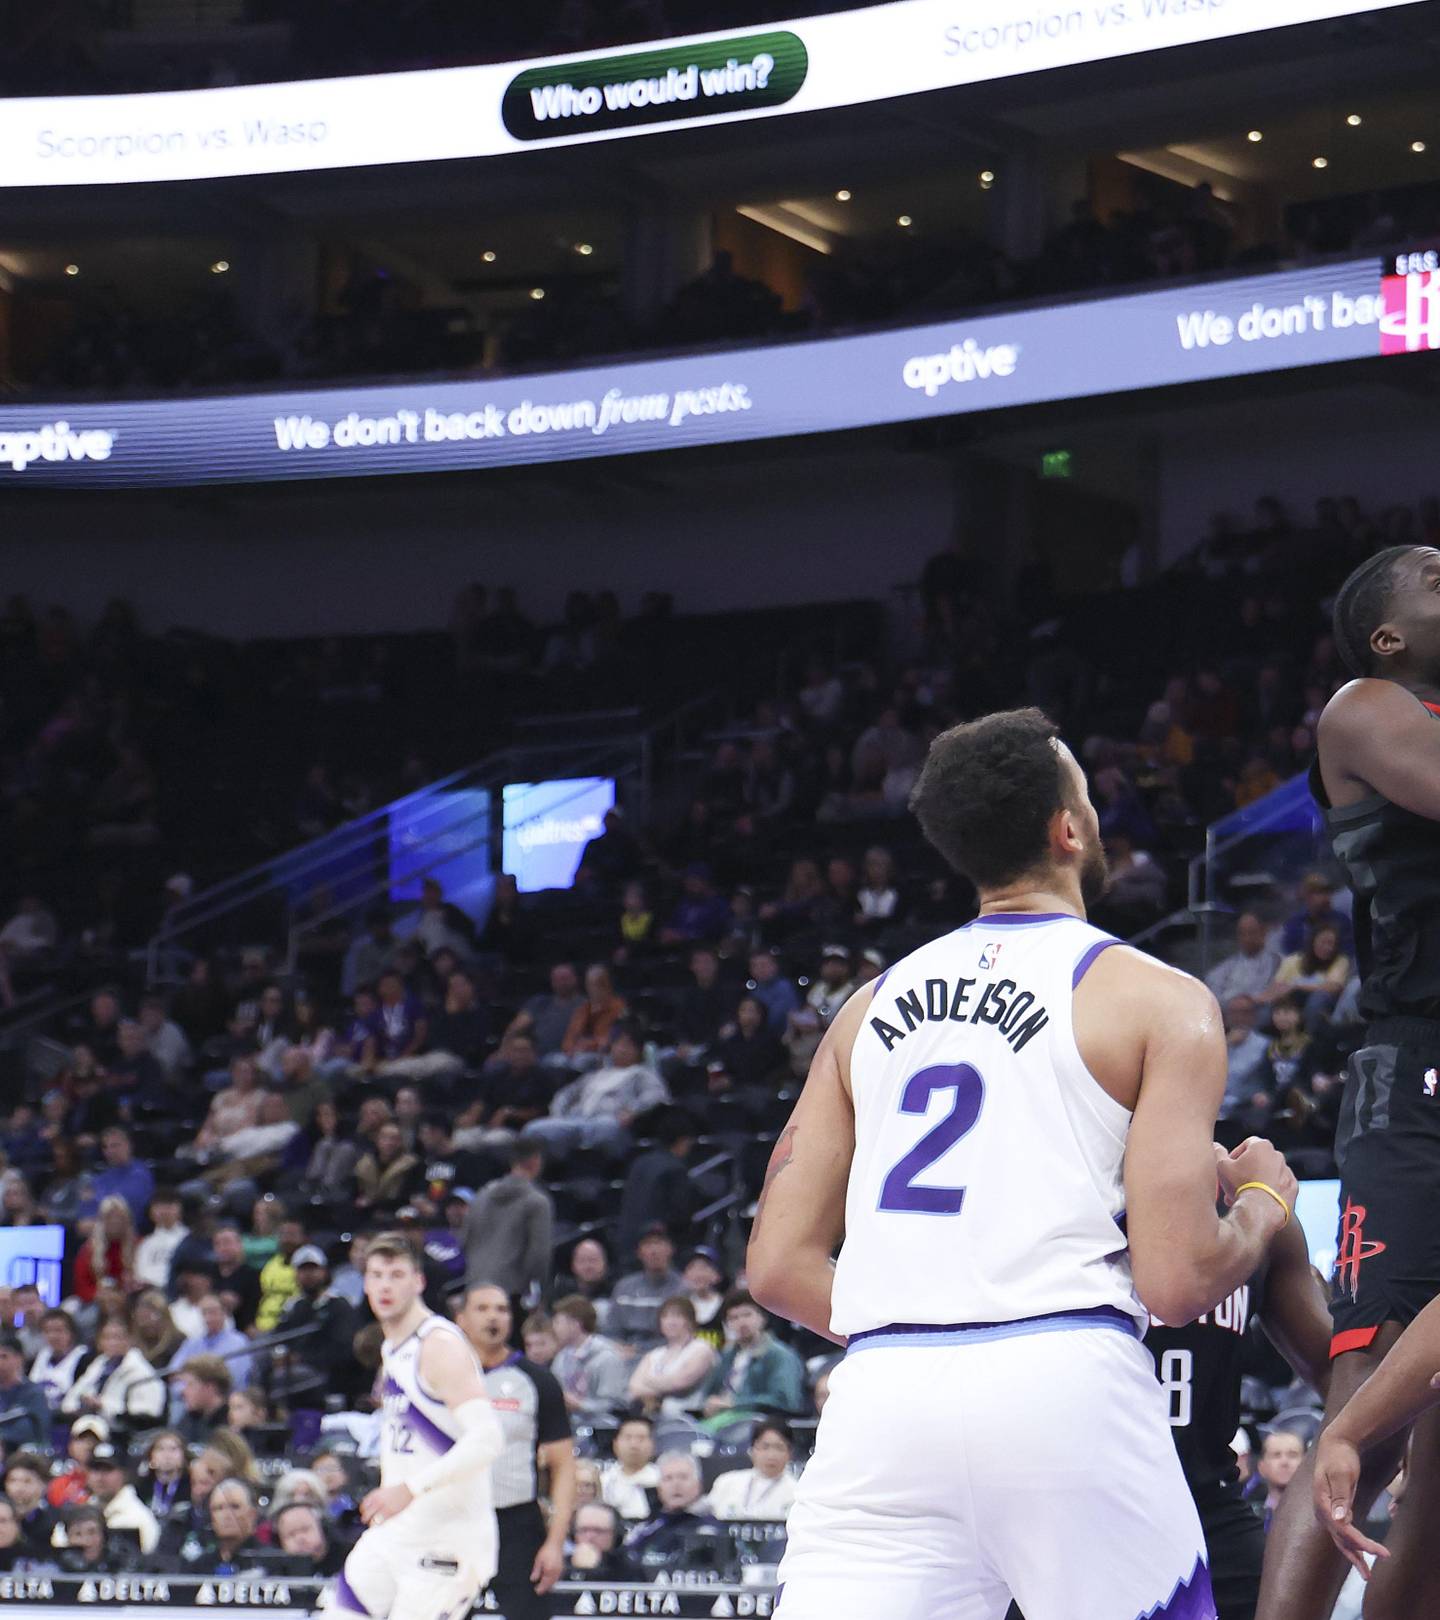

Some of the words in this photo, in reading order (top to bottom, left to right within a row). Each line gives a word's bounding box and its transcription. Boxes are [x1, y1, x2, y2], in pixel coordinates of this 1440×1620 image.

[944, 10, 1082, 57] Scorpion
[530, 82, 602, 121] Who
[603, 65, 699, 110] would
[700, 53, 774, 96] win?
[36, 126, 185, 158] Scorpion
[243, 117, 328, 150] Wasp
[902, 337, 1018, 396] aptive
[1176, 310, 1233, 349] We
[1237, 294, 1326, 341] don't
[274, 415, 329, 450] We
[333, 408, 418, 448] don't
[424, 402, 506, 442] back
[507, 399, 597, 435] down
[592, 387, 669, 435] from
[668, 382, 754, 427] pests.
[874, 1060, 987, 1217] 2
[1160, 1349, 1194, 1427] 8
[390, 1423, 415, 1454] 12
[99, 1576, 171, 1602] DELTA
[217, 1580, 292, 1605] DELTA
[599, 1590, 681, 1615] DELTA
[736, 1592, 775, 1617] DE
